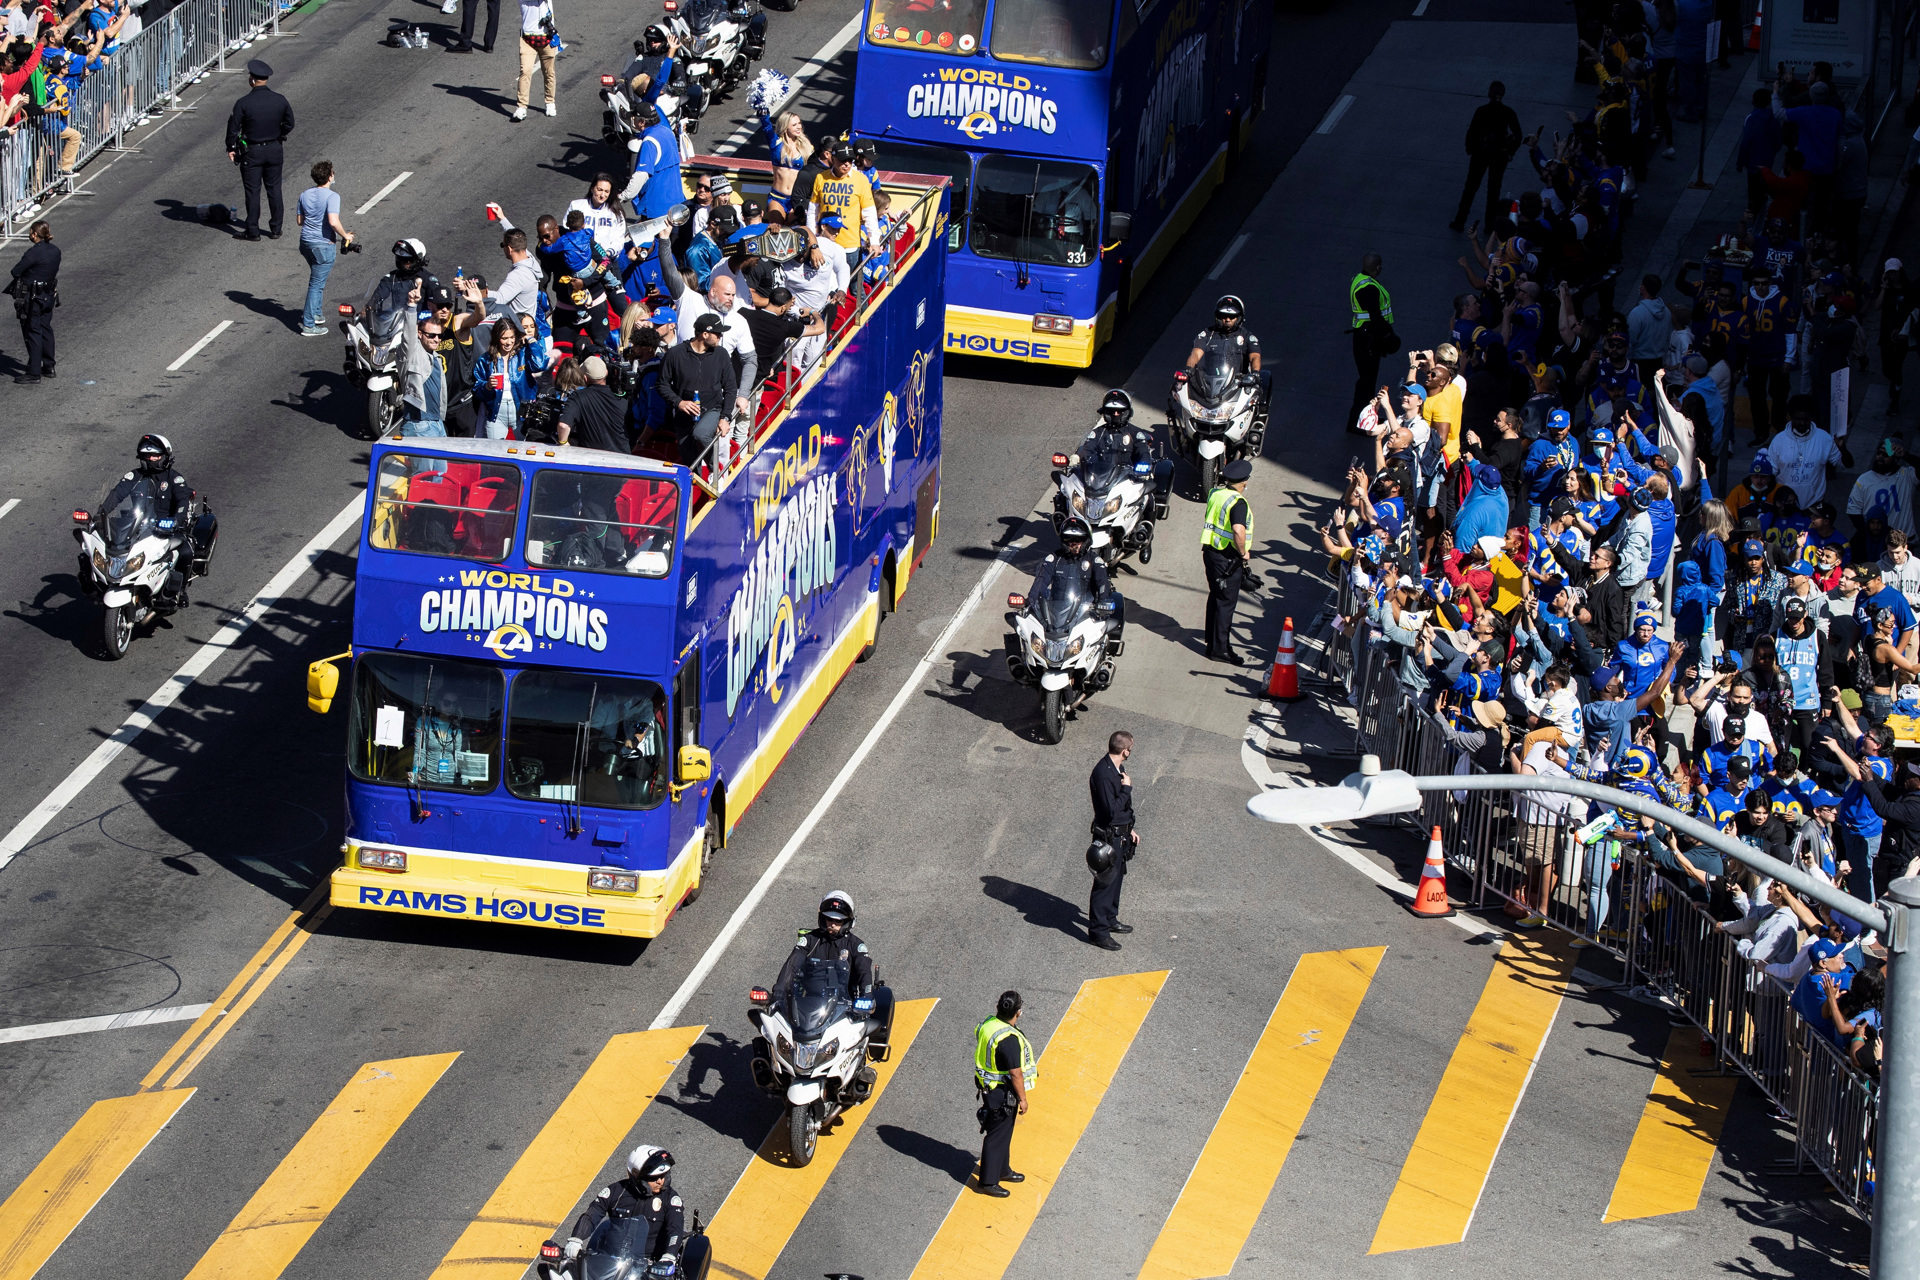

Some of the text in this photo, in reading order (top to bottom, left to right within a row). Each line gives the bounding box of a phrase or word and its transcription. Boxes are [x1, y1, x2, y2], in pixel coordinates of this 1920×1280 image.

[939, 68, 1031, 91] WORLD
[907, 83, 1058, 135] CHAMPIONS
[823, 183, 854, 194] RAMS
[823, 194, 850, 207] LOVE
[1067, 252, 1087, 264] 331
[947, 332, 1050, 359] HOUSE
[753, 423, 822, 542] WORLD
[459, 570, 575, 597] WORLD
[726, 471, 838, 718] CHAMPIONS
[420, 589, 609, 652] CHAMPIONS
[466, 633, 480, 642] 20
[539, 642, 553, 650] 21
[1790, 666, 1800, 680] 8
[359, 886, 606, 928] RAMS HOUSE
